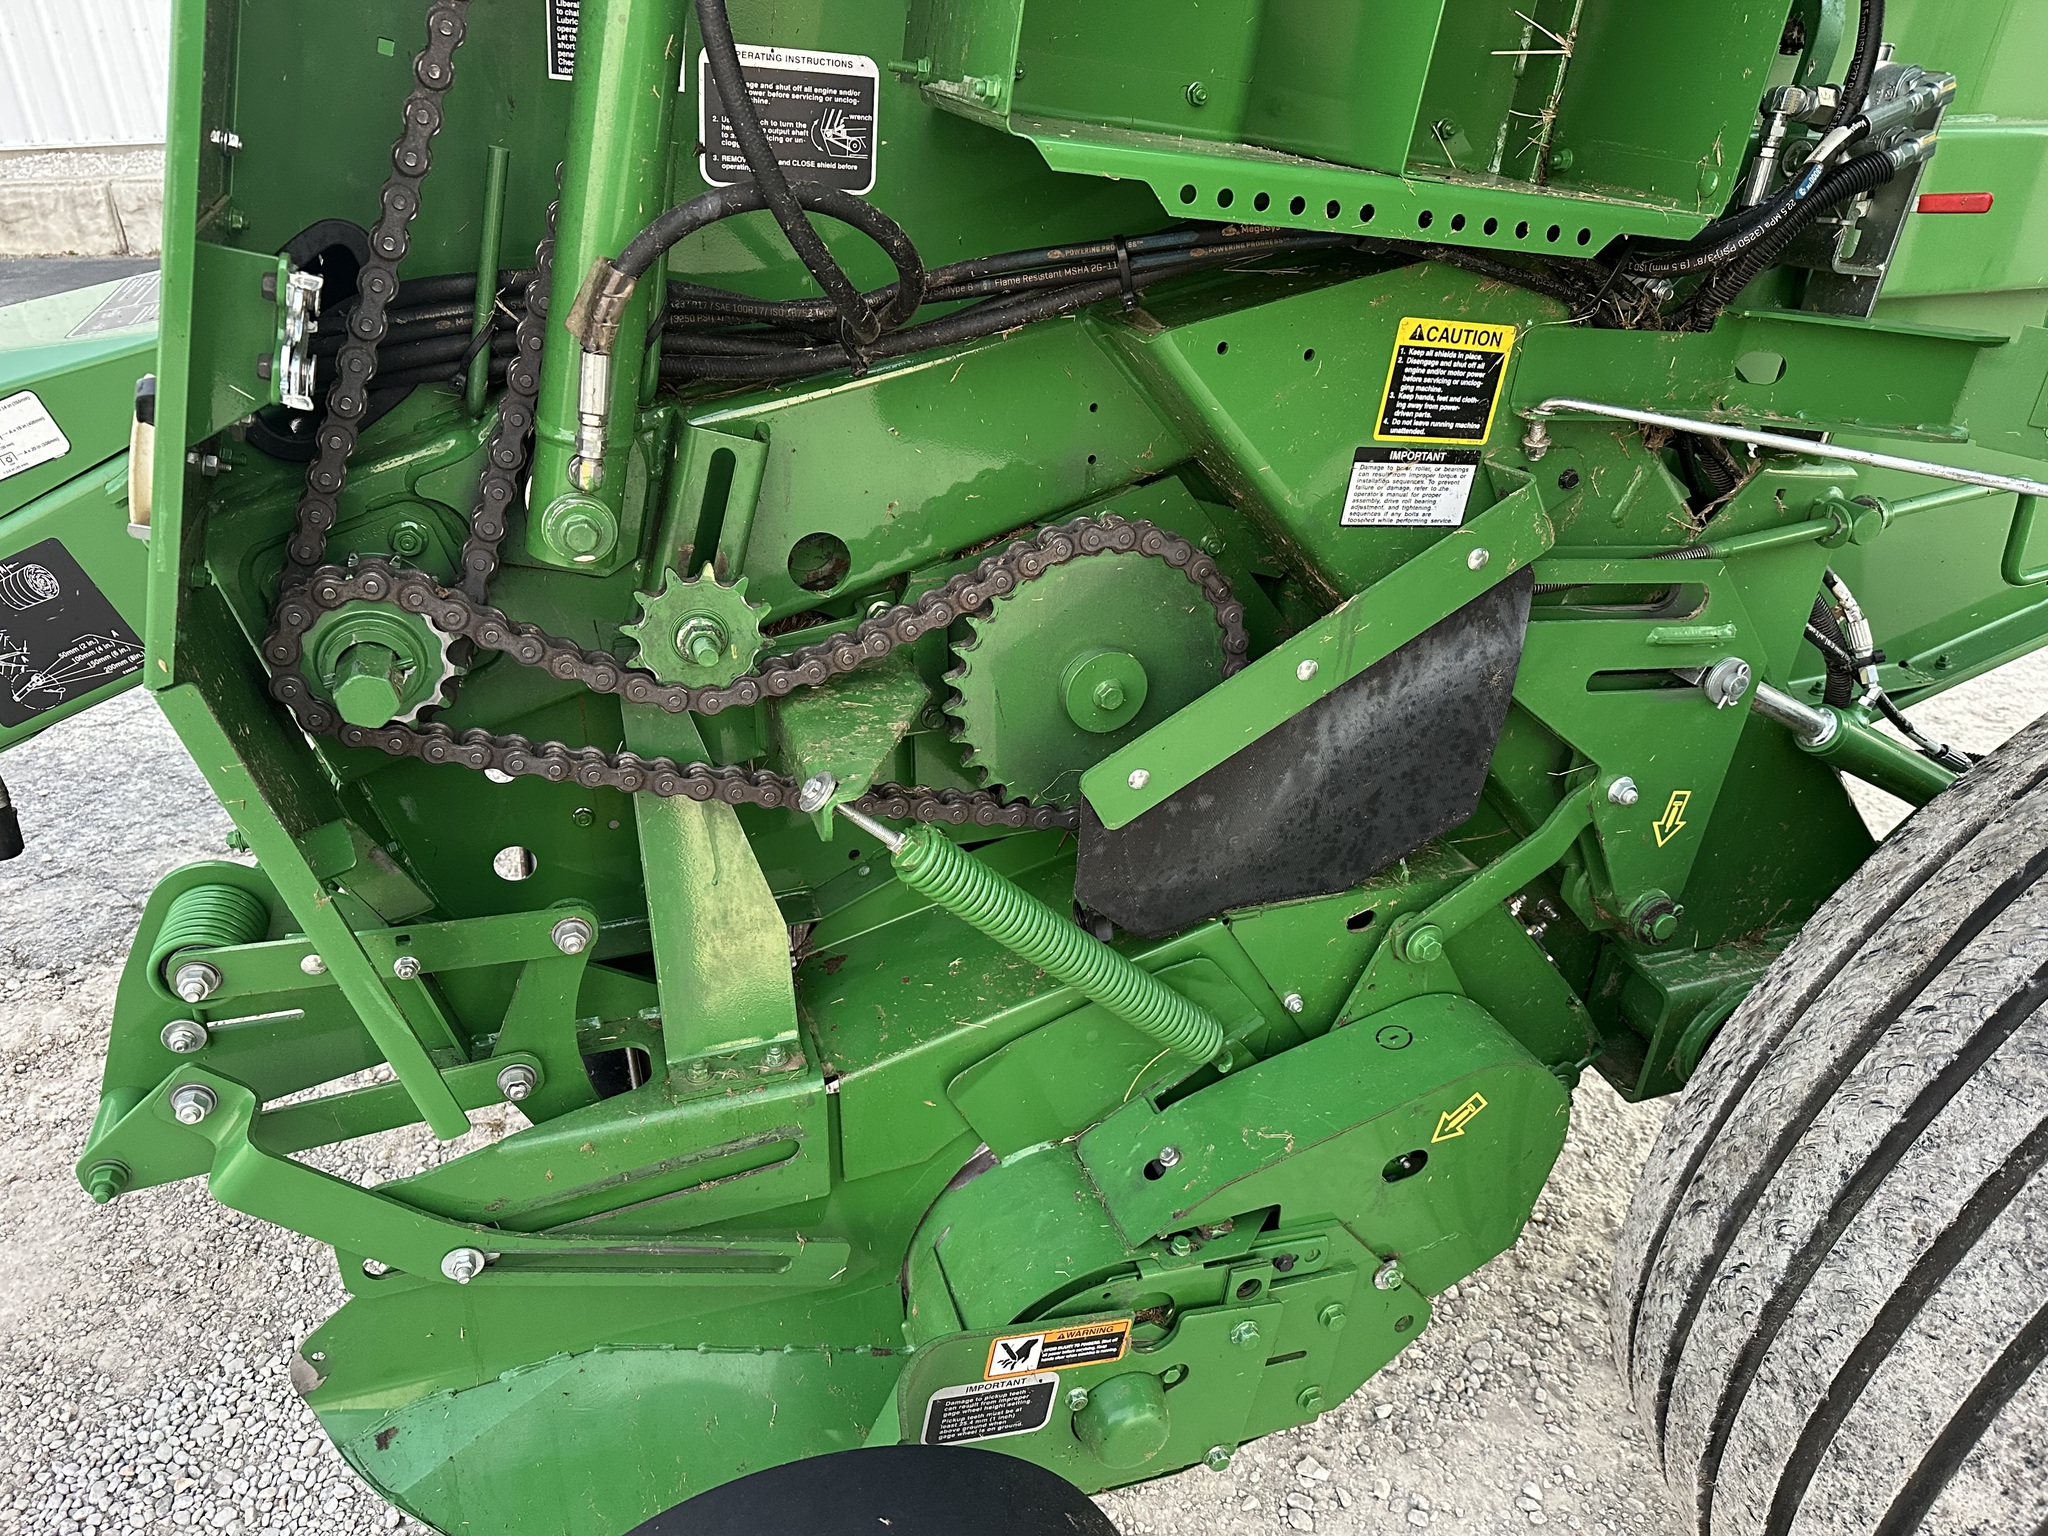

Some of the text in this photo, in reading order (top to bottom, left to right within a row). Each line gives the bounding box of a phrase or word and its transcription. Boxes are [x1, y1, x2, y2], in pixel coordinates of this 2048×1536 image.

[557, 16, 578, 25] Lubric
[558, 42, 576, 50] short
[736, 50, 853, 69] PERATING INSTRUCTIONS
[760, 81, 773, 89] and
[776, 83, 791, 91] shut
[792, 84, 802, 92] off
[814, 87, 837, 96] engine
[839, 89, 860, 97] and/or
[768, 91, 791, 99] before
[792, 93, 824, 102] servicing
[834, 97, 860, 106] unclog-
[780, 120, 794, 128] turn
[768, 128, 790, 136] output
[792, 160, 816, 168] CLOSE
[1780, 199, 1797, 216] 22.5
[1764, 212, 1782, 228] MPa
[1737, 225, 1765, 248] (3250
[1065, 246, 1100, 256] POWERING
[1208, 242, 1246, 254] POWERING
[1649, 262, 1670, 272] mm)
[1672, 259, 1690, 270] (9.5
[994, 276, 1021, 288] Flame
[1022, 270, 1062, 283] Resistant
[1064, 264, 1090, 277] MSHA
[715, 302, 730, 312] SAE
[770, 308, 783, 316] ISO
[670, 314, 696, 324] (3250
[1426, 326, 1503, 347] CAUTION
[1408, 348, 1424, 357] Keep
[1434, 350, 1456, 358] shields
[1398, 356, 1404, 364] 2.
[1406, 357, 1439, 367] Disengage
[1423, 377, 1452, 386] servicing
[1400, 384, 1443, 393] ging machine.
[1398, 392, 1414, 401] Keep
[1414, 393, 1436, 402] hands,
[1396, 401, 1406, 409] ing
[1424, 402, 1438, 410] from
[1402, 418, 1412, 426] not
[1430, 420, 1454, 429] running
[1389, 450, 1448, 462] IMPORTANT
[111, 630, 119, 638] A
[58, 638, 100, 659] 50mm in.)
[72, 640, 116, 663] 100mm in.)
[87, 655, 112, 668] 150mm
[104, 660, 128, 674] 200mm
[1066, 1326, 1114, 1338] WARNING
[966, 1378, 1028, 1394] IMPORTANT
[946, 1398, 974, 1406] Damage
[984, 1393, 1008, 1401] pickup
